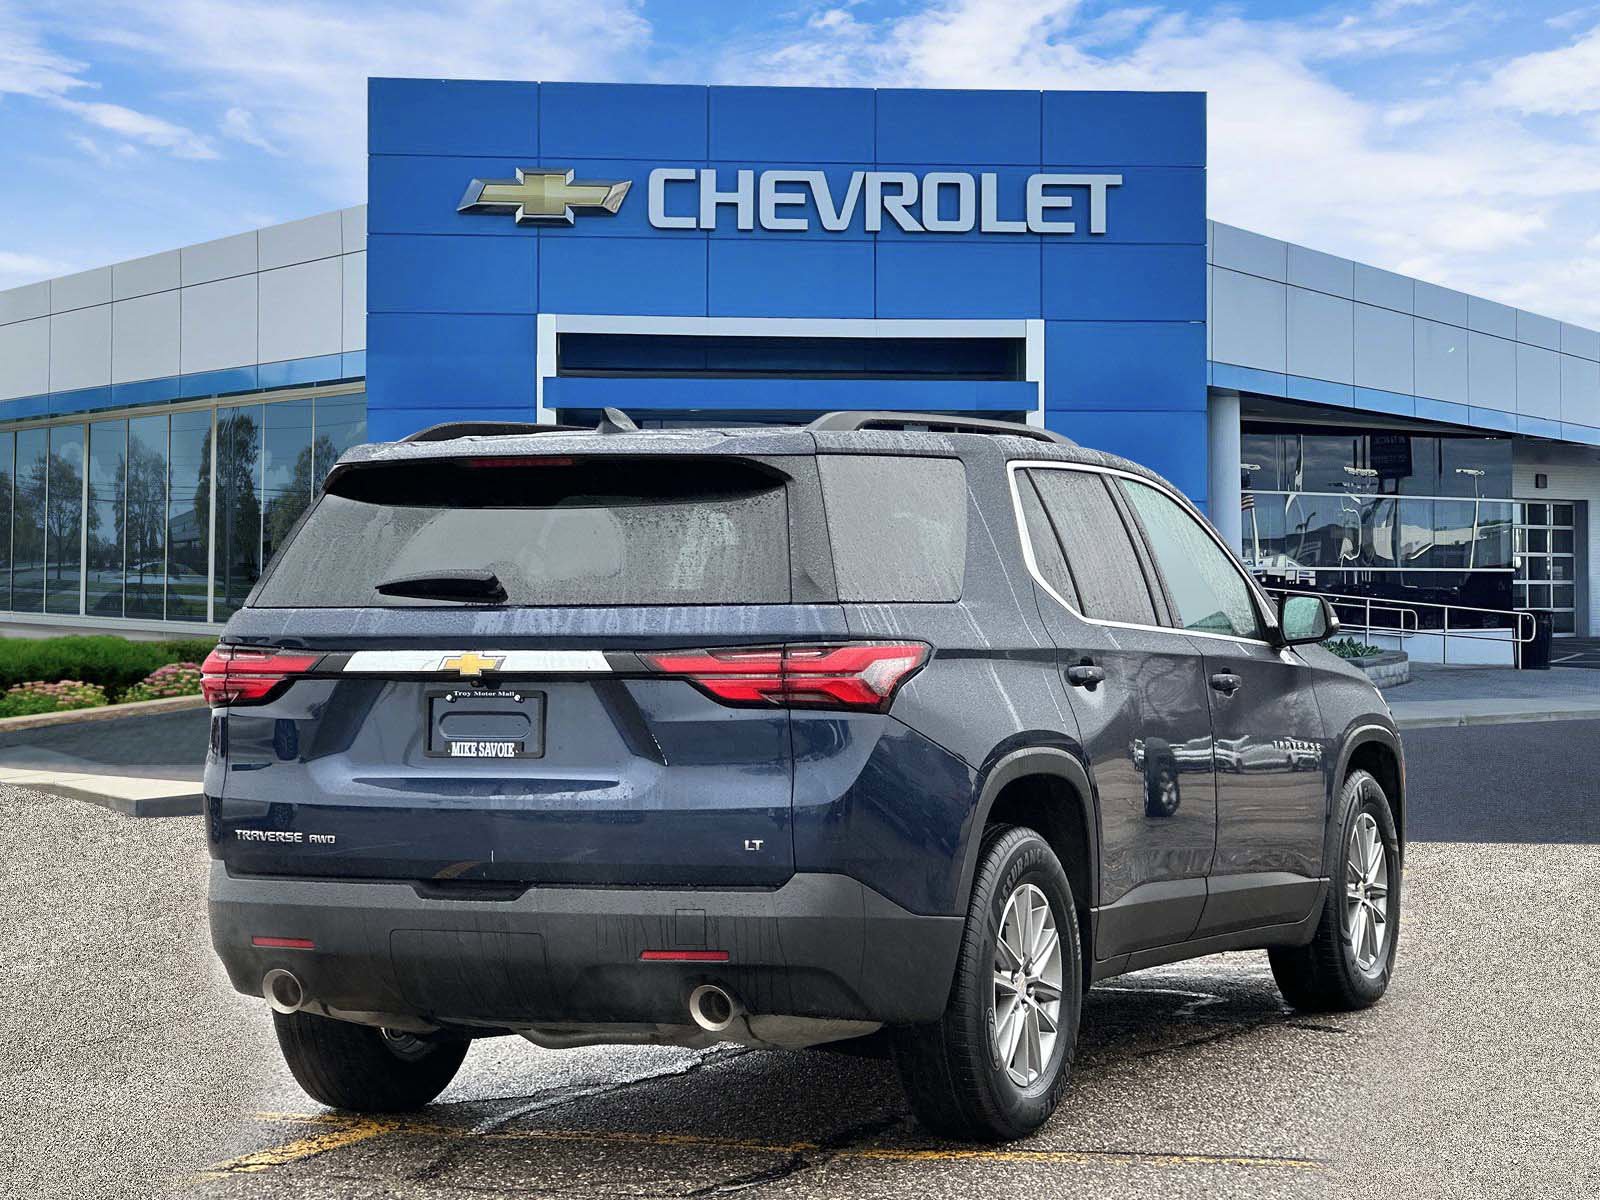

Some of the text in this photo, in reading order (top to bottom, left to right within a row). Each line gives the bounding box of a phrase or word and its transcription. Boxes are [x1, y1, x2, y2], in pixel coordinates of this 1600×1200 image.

[648, 167, 1123, 235] CHEVROLET
[451, 741, 515, 758] MIKE SAVOIE
[235, 829, 336, 844] TRAVERSE AWD
[744, 839, 764, 851] LT
[998, 847, 1049, 915] ASSURANCE
